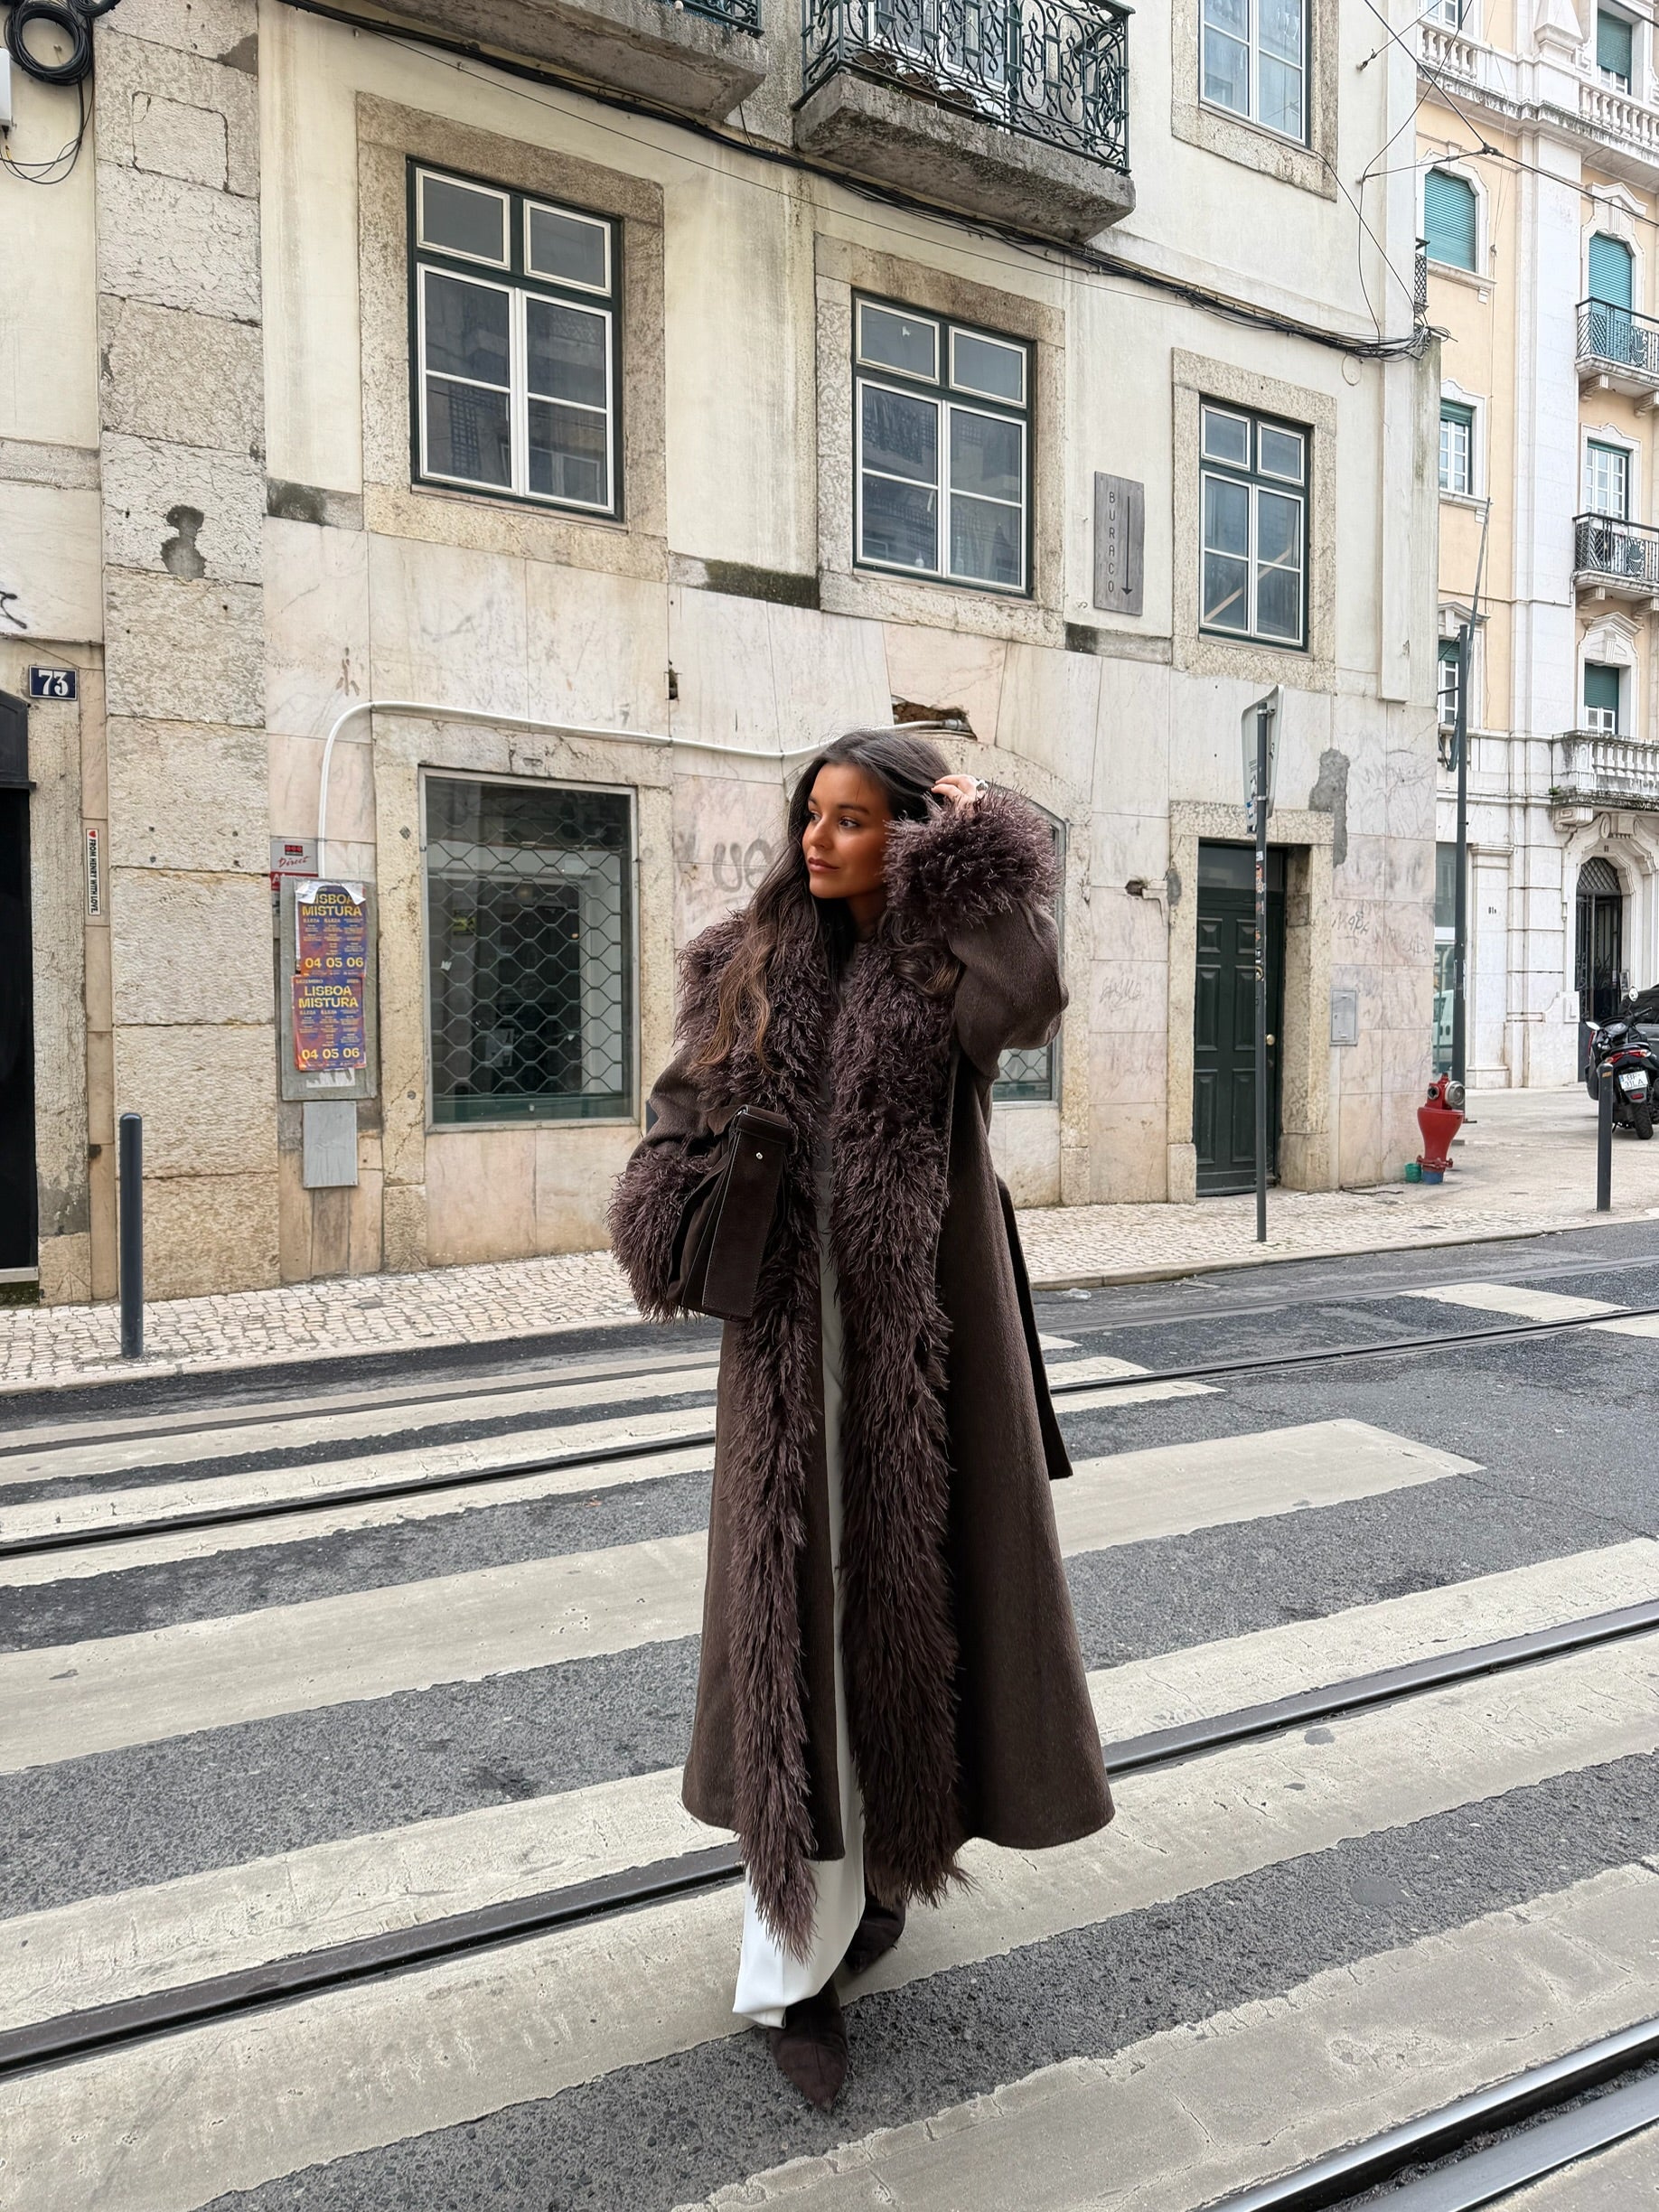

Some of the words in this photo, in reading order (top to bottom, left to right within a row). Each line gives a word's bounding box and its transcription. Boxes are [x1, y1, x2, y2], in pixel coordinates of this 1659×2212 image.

[38, 669, 69, 697] 73
[89, 839, 97, 857] FROM
[89, 858, 98, 878] HENRY
[278, 856, 312, 868] Direct
[89, 879, 98, 895] WITH
[315, 893, 355, 904] ISBOA
[302, 905, 362, 917] MISTURA
[305, 957, 323, 970] 04
[325, 957, 343, 969] 05
[346, 956, 364, 969] 06
[304, 985, 352, 997] LISBOA
[298, 997, 359, 1008] MISTURA
[301, 1048, 319, 1061] 04
[322, 1048, 340, 1060] 05
[342, 1047, 361, 1059] 06
